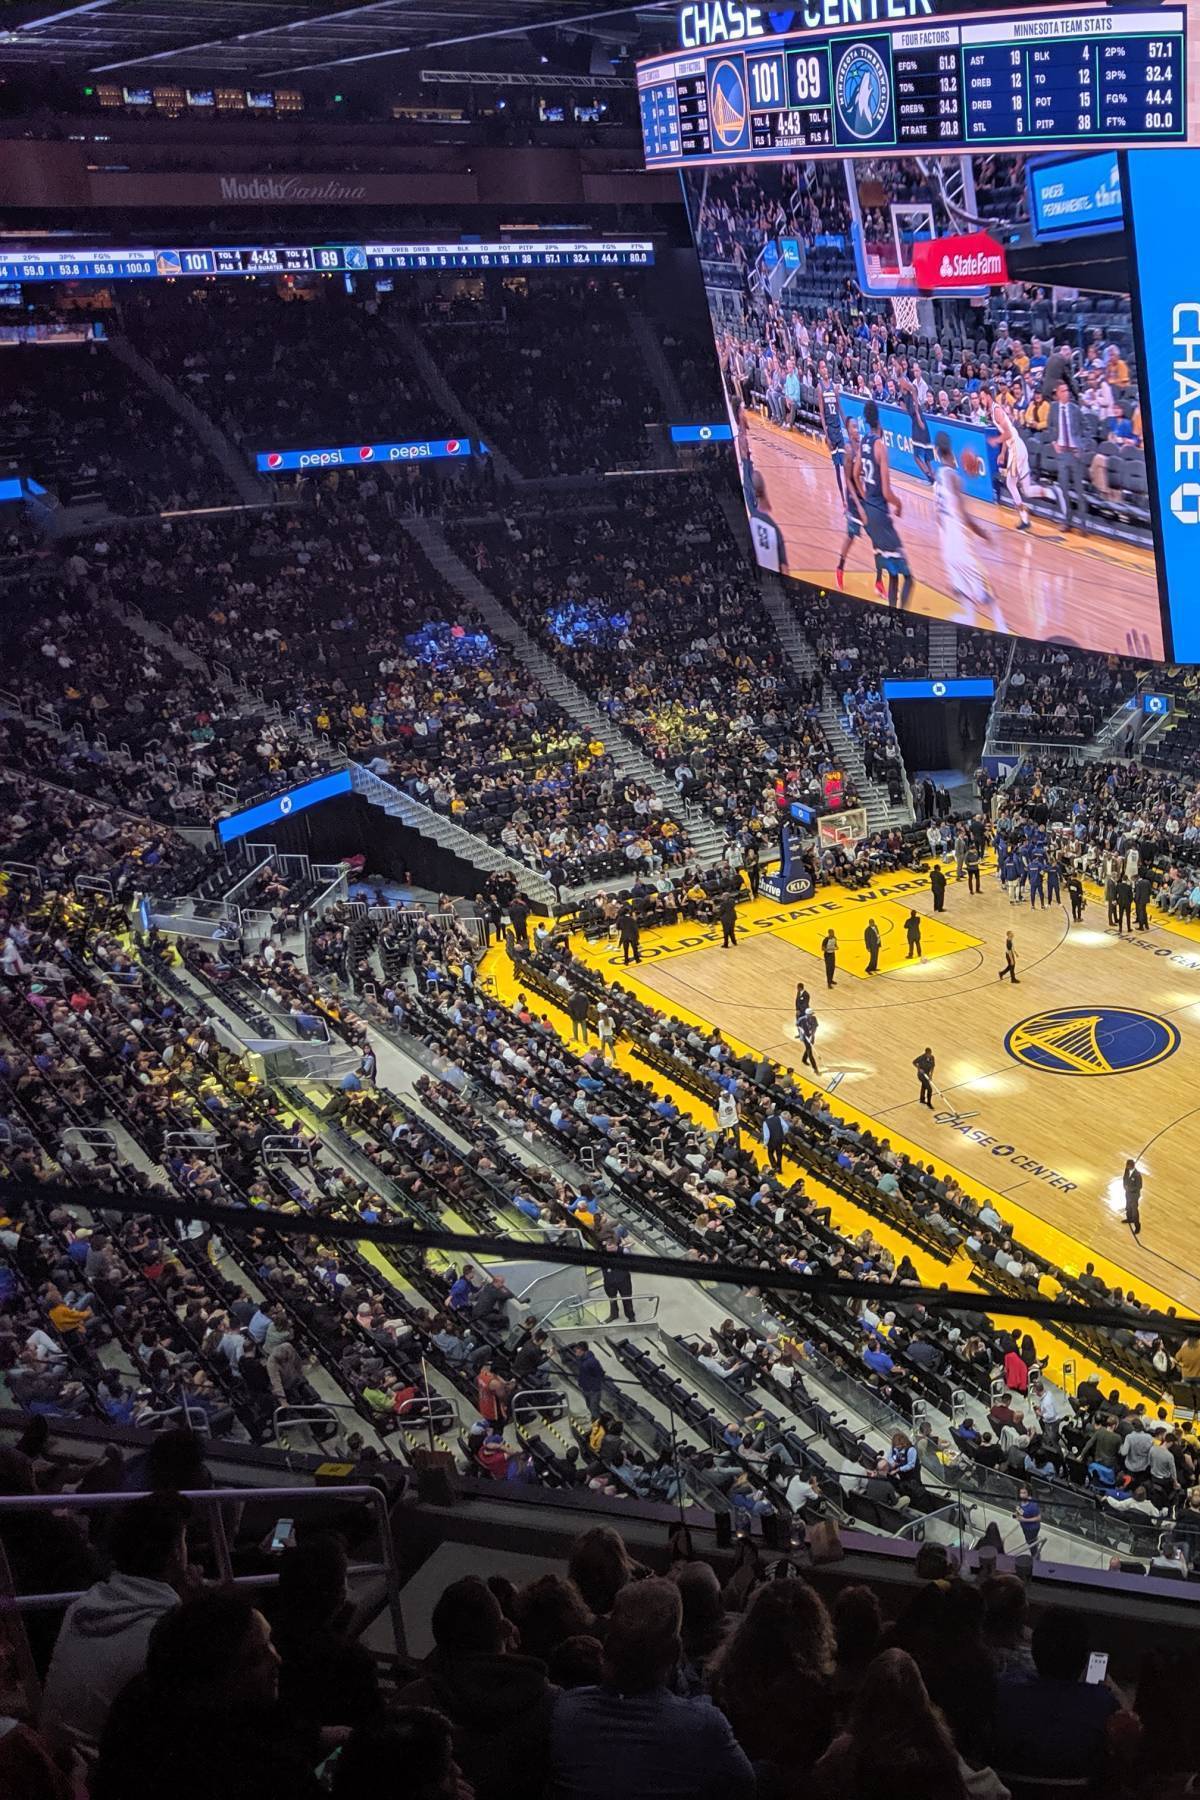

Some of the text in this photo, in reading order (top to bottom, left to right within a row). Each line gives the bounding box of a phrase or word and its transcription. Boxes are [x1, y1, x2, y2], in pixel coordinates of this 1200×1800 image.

[681, 1, 765, 48] CHASE
[1013, 17, 1112, 37] MINNESOTA TEAM STATS
[902, 31, 950, 46] FOUR FACTORS
[970, 50, 1021, 65] AST 19
[1034, 45, 1089, 61] BLK 4
[1105, 43, 1173, 58] 2P% 57.1
[939, 55, 956, 70] 61.8
[796, 57, 821, 100] 89
[971, 73, 1022, 88] OREB 12
[1035, 69, 1090, 84] TO 12
[1106, 66, 1173, 82] 3P% 32.4
[752, 62, 780, 103] 101
[900, 77, 957, 93] TO% 13.2
[972, 96, 1022, 110] DREB 18
[1036, 92, 1090, 107] POT 15
[1106, 89, 1173, 105] FG% 44.4
[900, 99, 958, 114] OREB% 34.3
[754, 117, 765, 127] TOL
[778, 112, 801, 135] 4:43
[809, 110, 828, 123] TOL 4
[1036, 115, 1091, 130] PITP 38
[1106, 113, 1173, 128] FT% 80.0
[940, 121, 959, 136] 20.8
[973, 118, 1023, 133] STL 5
[784, 138, 806, 146] QUARTER
[810, 131, 829, 143] FLS 4
[220, 177, 367, 200] Modelo Cantina
[234, 251, 241, 259] 4
[251, 251, 278, 264] 4:43
[302, 249, 308, 258] 4
[321, 251, 338, 266] 89
[396, 257, 406, 266] 12
[461, 255, 467, 265] 4
[481, 255, 489, 265] 12
[601, 253, 618, 263] 44.4
[126, 263, 151, 274] 100.0
[185, 254, 208, 270] 101
[300, 443, 430, 468] pepsi pepsi
[789, 881, 808, 892] KIA
[754, 900, 844, 928] STATE
[1104, 929, 1159, 951] CHASE
[933, 1111, 1078, 1194] CHASE CENTER
